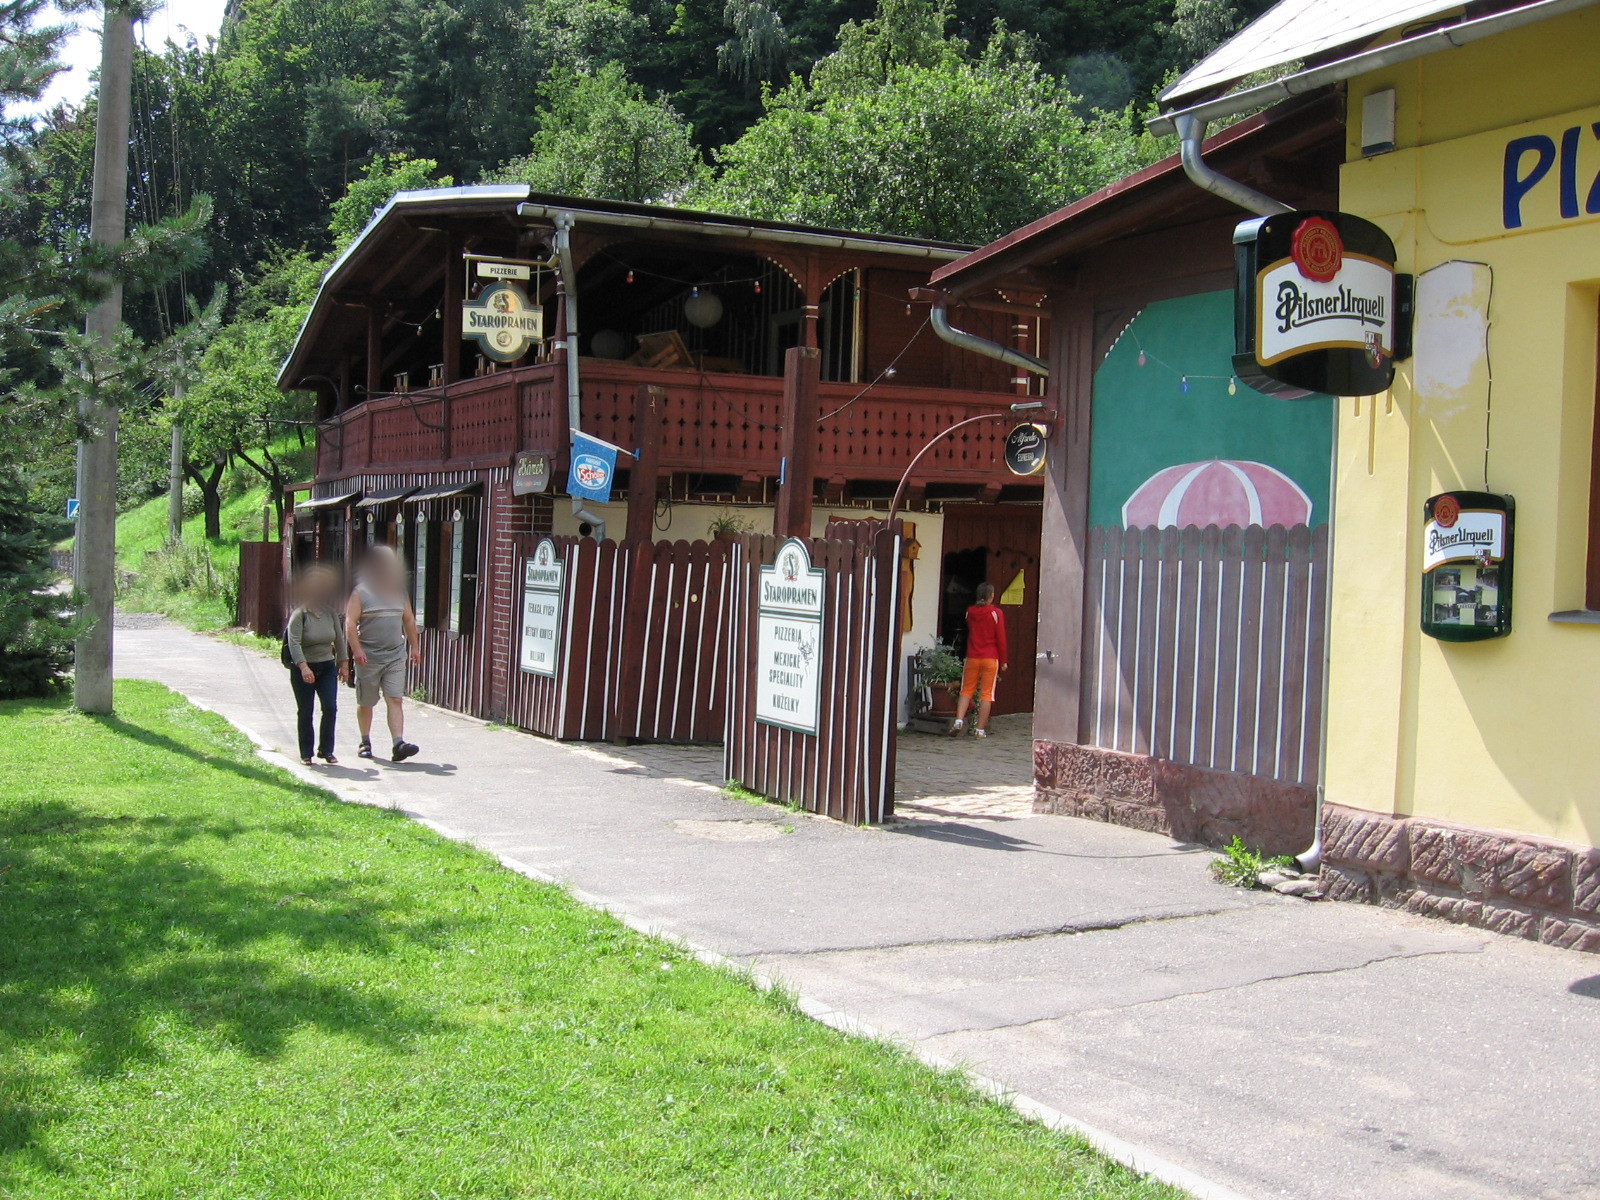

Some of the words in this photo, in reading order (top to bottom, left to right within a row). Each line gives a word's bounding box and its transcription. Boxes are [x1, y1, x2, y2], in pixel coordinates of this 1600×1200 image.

[490, 267, 517, 276] PIZZERIE
[1275, 280, 1339, 334] Pilsner
[1338, 283, 1385, 327] Urquell
[1428, 529, 1460, 556] Pilsner
[1458, 526, 1494, 547] Urquell
[774, 626, 802, 643] PIZZERIA
[769, 669, 805, 689] SPECIALITY
[773, 692, 800, 714] KUŽELKY
